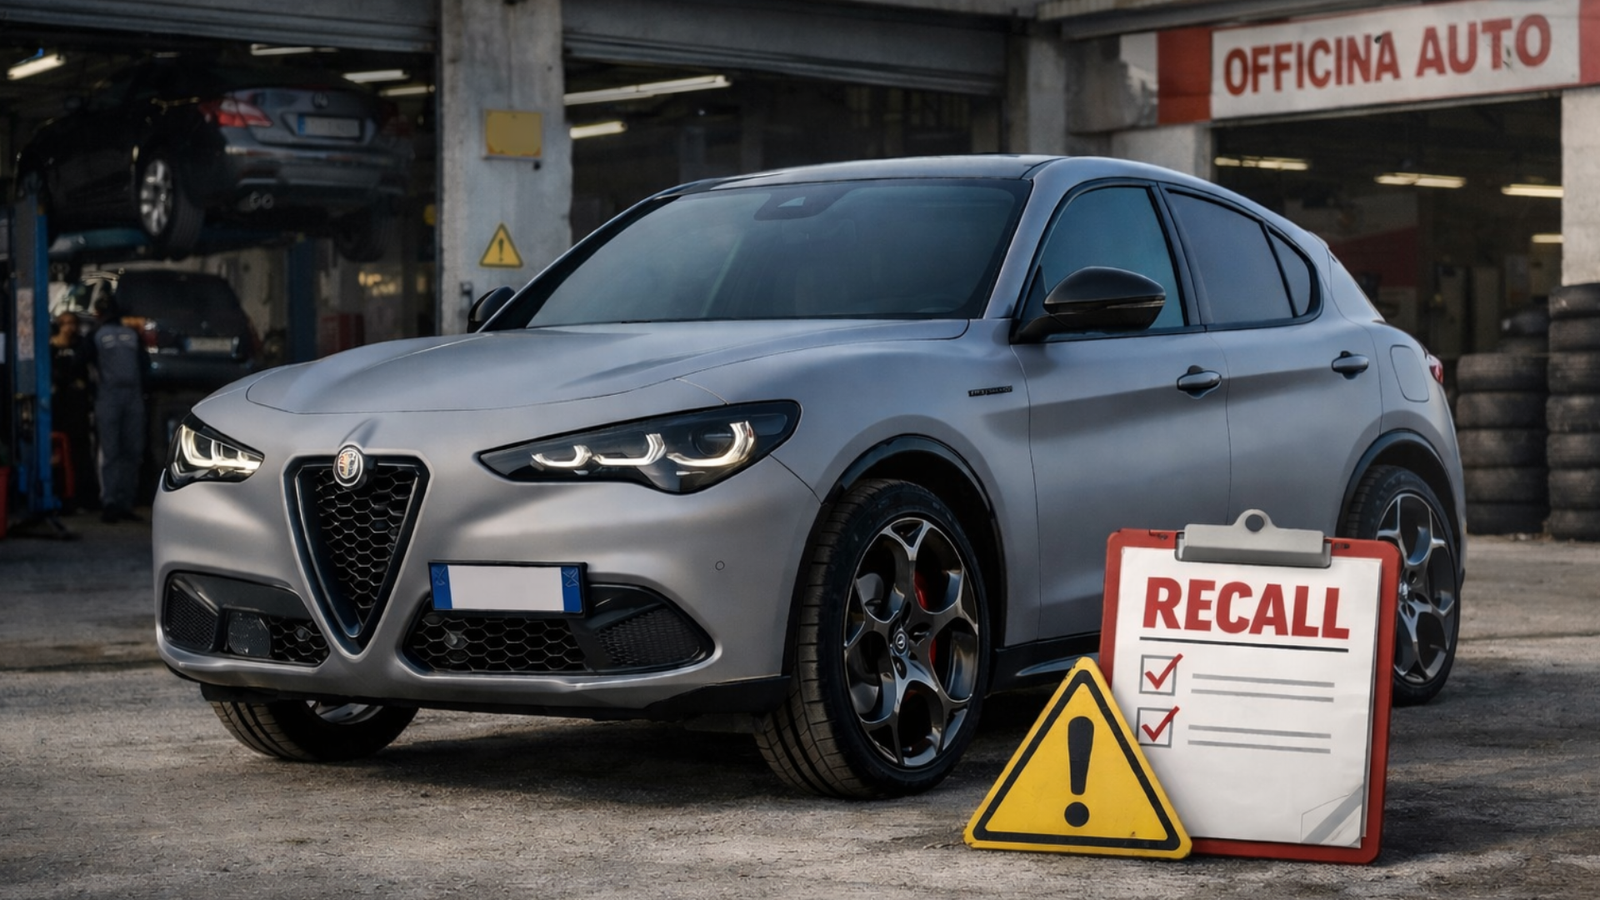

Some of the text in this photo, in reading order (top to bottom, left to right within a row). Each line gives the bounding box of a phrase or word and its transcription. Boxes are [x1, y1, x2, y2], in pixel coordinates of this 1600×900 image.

[1224, 14, 1551, 96] OFFICINA AUTO
[1142, 576, 1350, 640] RECALL
